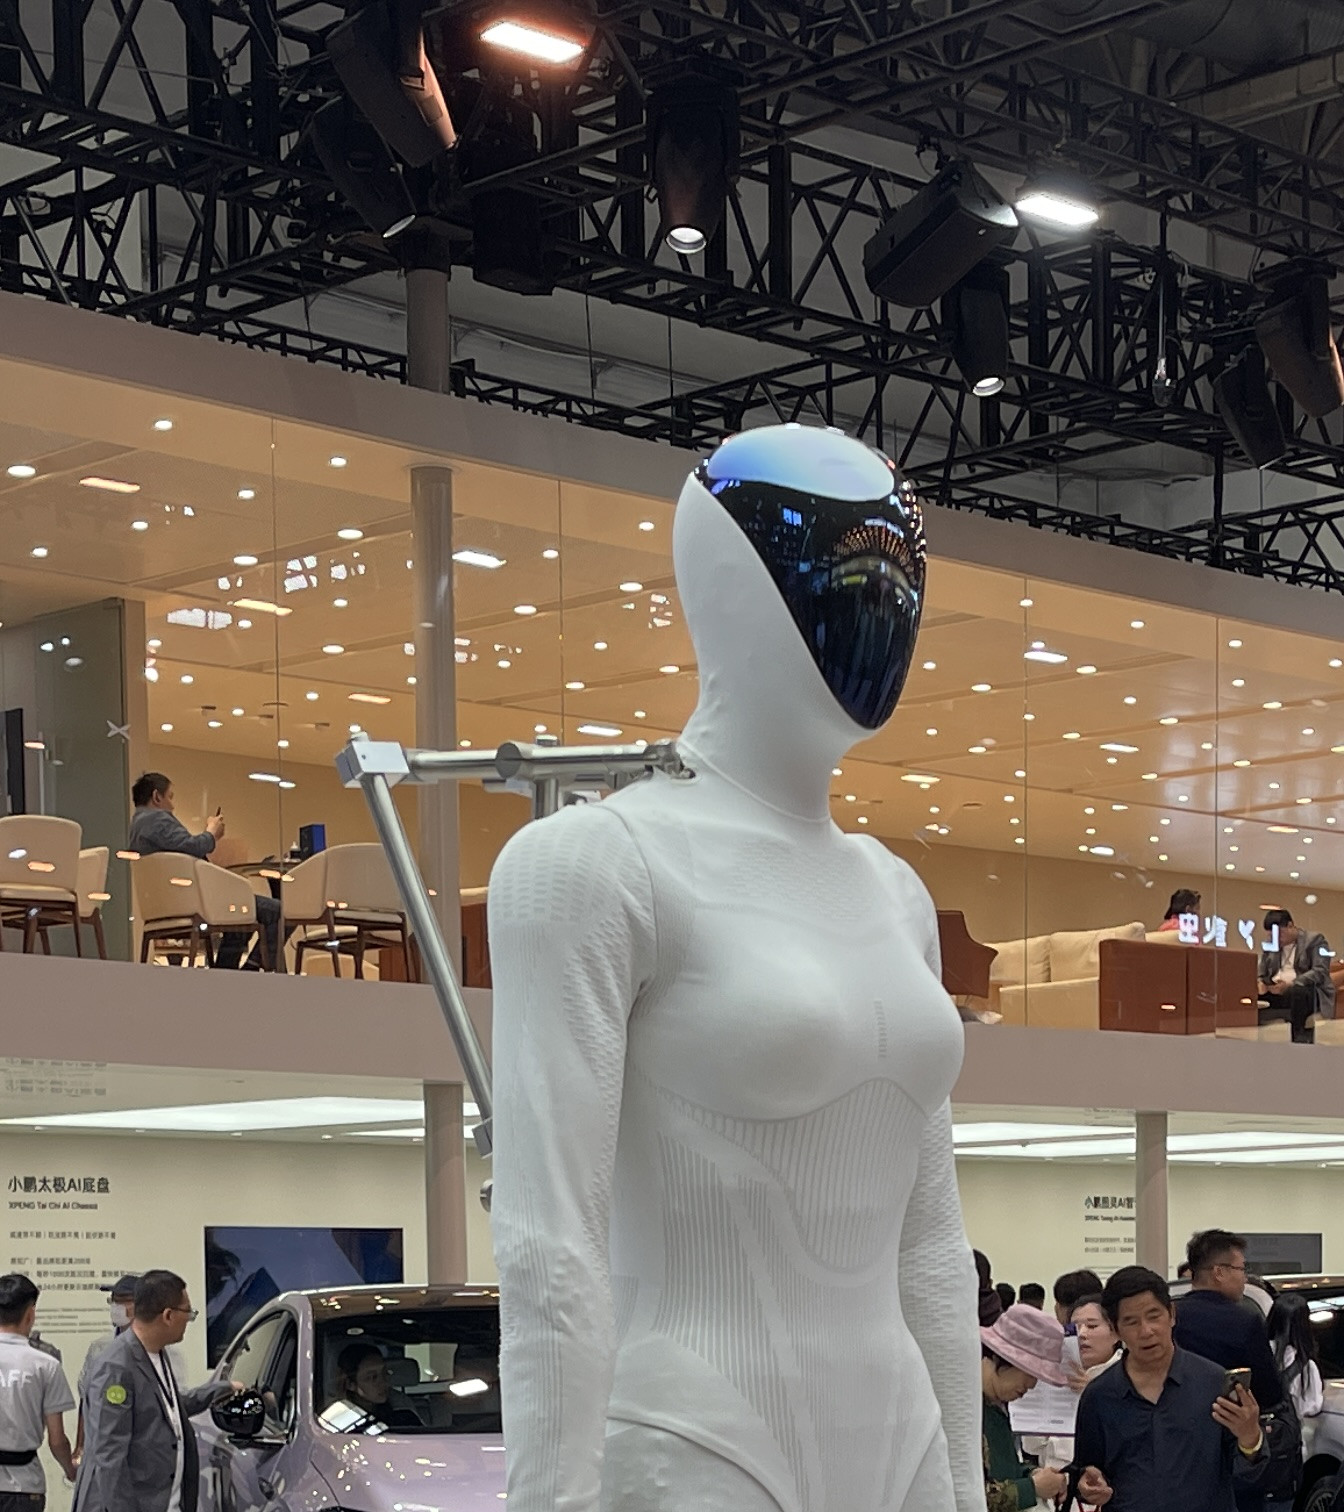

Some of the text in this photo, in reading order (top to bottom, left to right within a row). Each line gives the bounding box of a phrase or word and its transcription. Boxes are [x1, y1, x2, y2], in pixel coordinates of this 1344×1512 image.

[7, 1175, 110, 1194] 小鹏太极AI底盘
